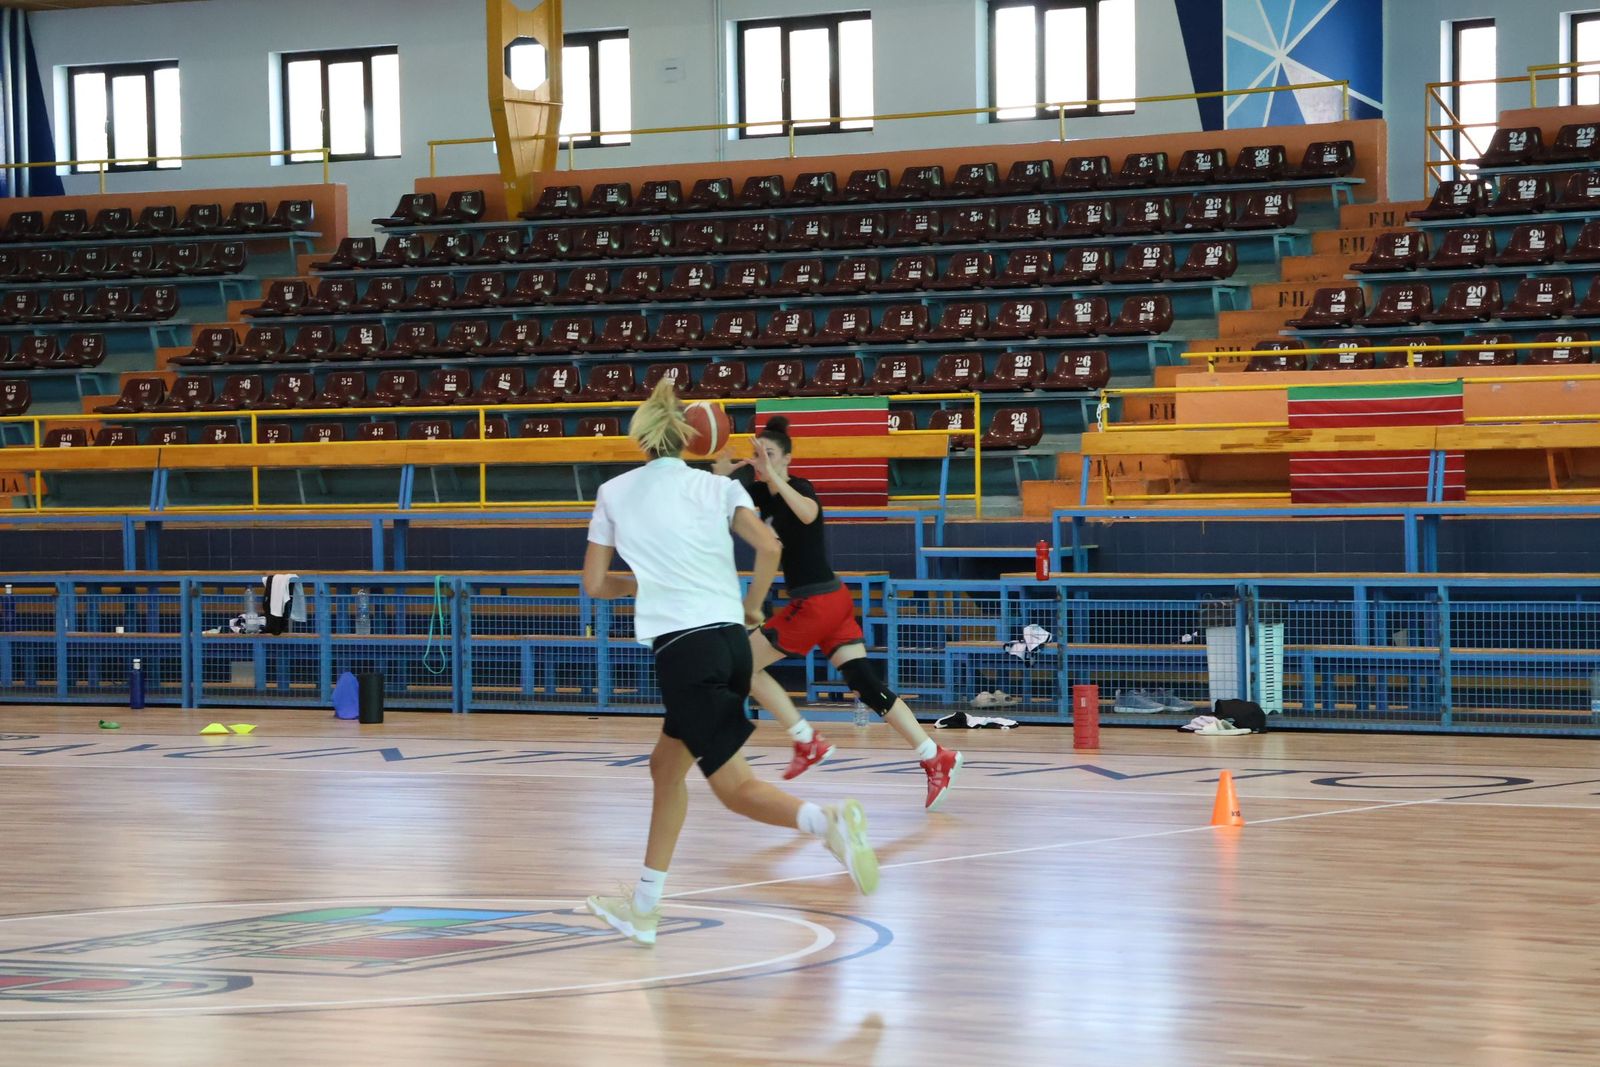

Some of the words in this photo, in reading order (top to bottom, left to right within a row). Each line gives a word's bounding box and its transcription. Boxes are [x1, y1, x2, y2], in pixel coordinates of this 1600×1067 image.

[1509, 132, 1526, 144] 24
[1576, 128, 1595, 140] 22
[1196, 153, 1210, 163] 30
[1255, 149, 1269, 160] 28
[1081, 161, 1094, 171] 34
[1139, 157, 1152, 168] 32
[1026, 165, 1040, 175] 36
[1454, 184, 1471, 195] 24
[1518, 180, 1536, 192] 22
[1206, 199, 1221, 209] 28
[1265, 195, 1281, 206] 26
[1145, 202, 1158, 212] 30
[970, 212, 982, 222] 36
[1395, 235, 1409, 247] 24
[1530, 230, 1544, 241] 20
[1082, 252, 1098, 263] 30
[1144, 248, 1160, 258] 28
[1206, 246, 1222, 258] 26
[689, 268, 703, 278] 44
[1332, 291, 1346, 302] 24
[1468, 286, 1486, 298] 20
[1016, 305, 1032, 315] 30
[1075, 303, 1091, 314] 28
[1141, 301, 1154, 311] 26
[787, 314, 799, 324] 38
[1015, 356, 1031, 367] 28
[1077, 356, 1091, 367] 26
[553, 370, 567, 381] 44
[240, 379, 250, 389] 56
[949, 414, 962, 425] 28
[1011, 413, 1027, 424] 26
[164, 433, 176, 444] 56
